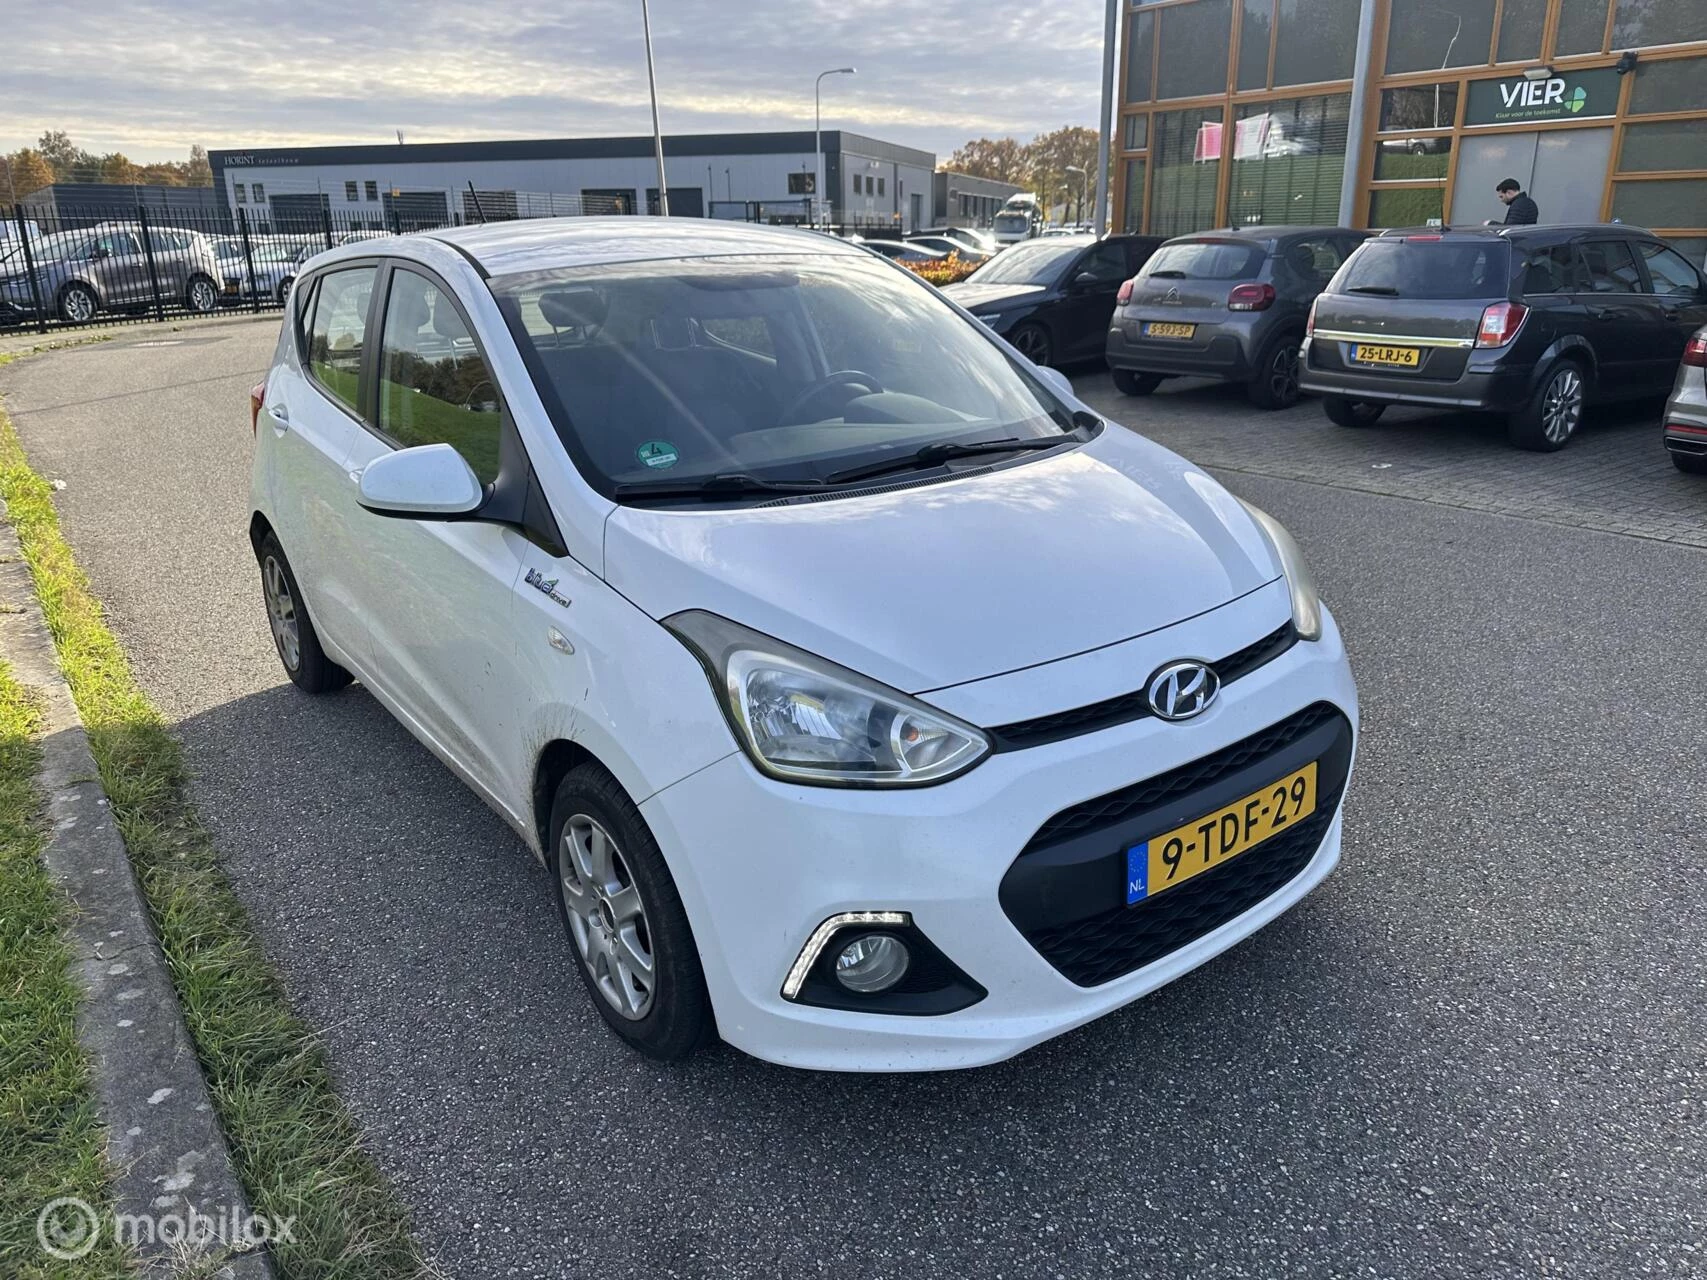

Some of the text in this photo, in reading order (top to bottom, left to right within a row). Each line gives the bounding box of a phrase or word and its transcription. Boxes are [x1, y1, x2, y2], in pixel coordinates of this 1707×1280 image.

[1500, 78, 1565, 108] VIER
[1360, 346, 1413, 363] 25-LRJ-6
[1129, 776, 1306, 895] NL 9-TDF-29
